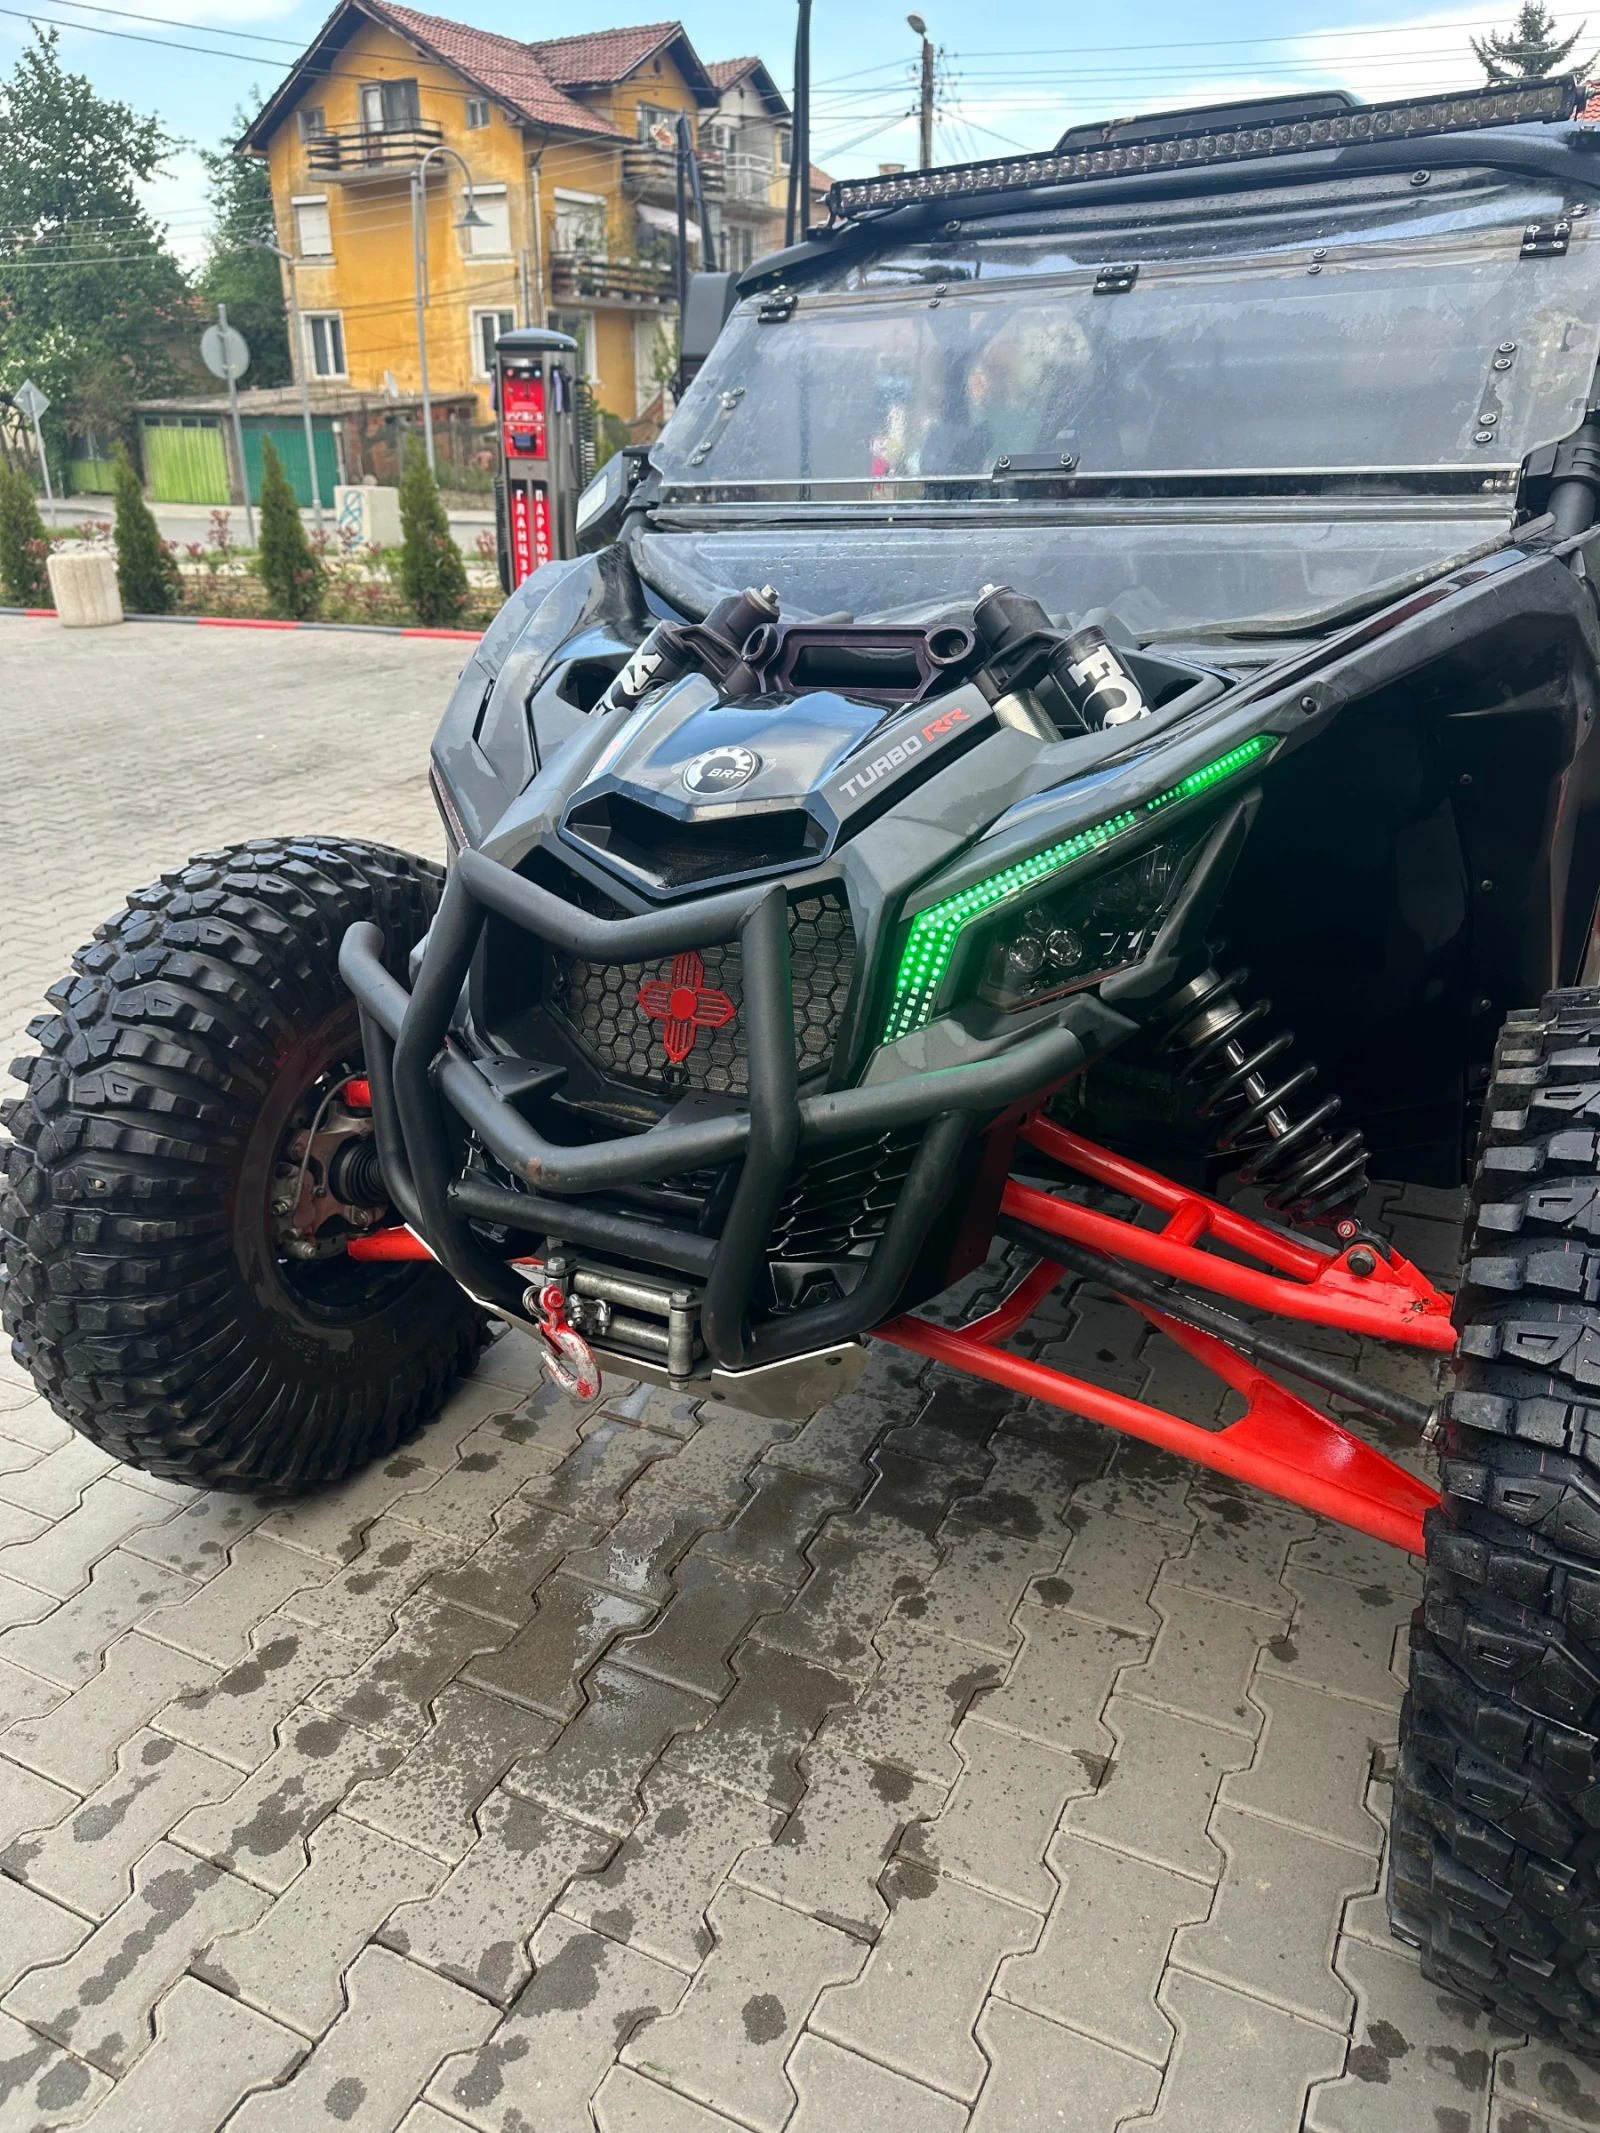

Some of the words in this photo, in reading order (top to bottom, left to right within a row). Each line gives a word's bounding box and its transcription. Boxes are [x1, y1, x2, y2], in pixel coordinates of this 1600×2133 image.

[1066, 644, 1152, 731] FO
[706, 768, 747, 779] BRP
[838, 735, 923, 798] TURBO
[921, 707, 971, 742] RR
